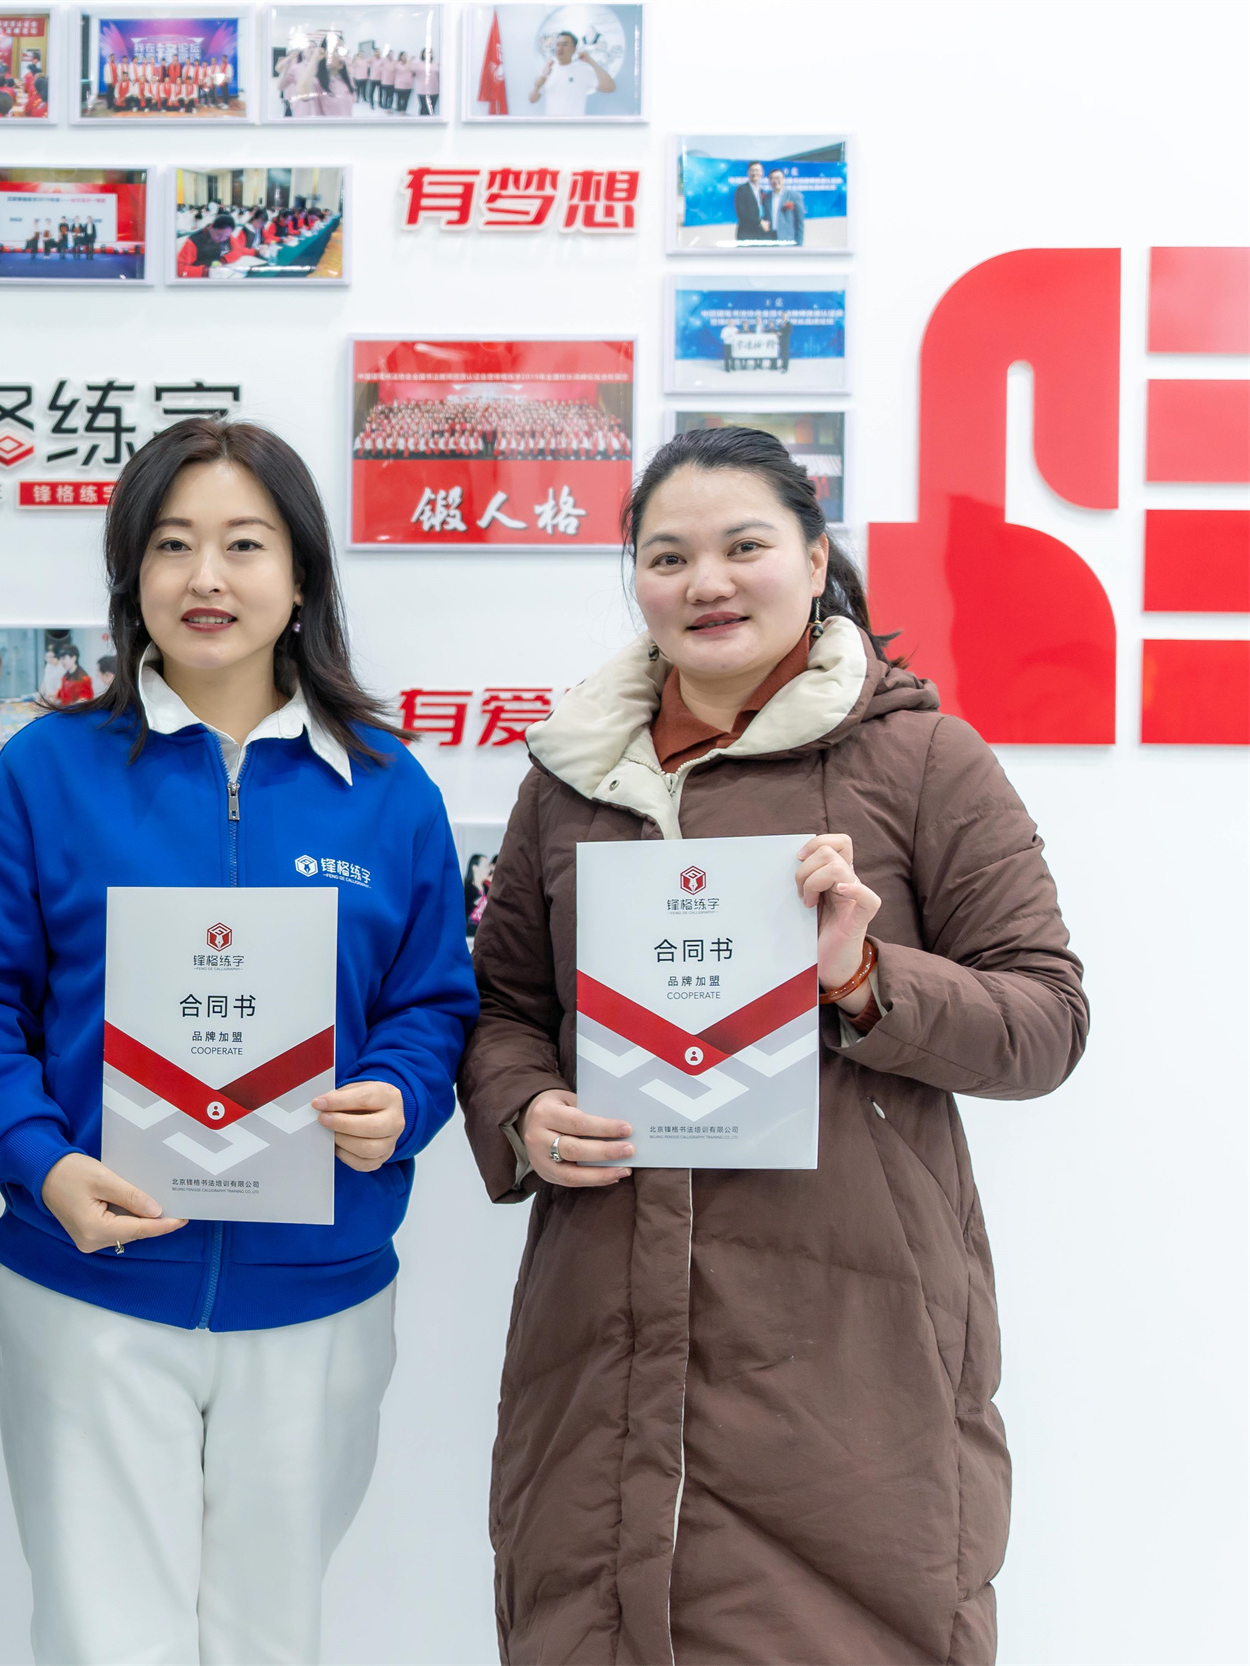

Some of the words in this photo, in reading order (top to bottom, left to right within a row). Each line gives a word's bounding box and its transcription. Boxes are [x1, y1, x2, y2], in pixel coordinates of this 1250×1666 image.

[405, 166, 639, 228] 有梦想
[411, 485, 587, 535] 锻人格
[398, 687, 578, 748] 有爱
[321, 857, 371, 884] 锋格练字
[667, 898, 719, 910] 锋格练字
[654, 937, 733, 963] 合同书
[193, 955, 245, 967] 锋格练字
[667, 975, 720, 987] 品牌加盟
[667, 991, 721, 1000] COOPERATE
[179, 993, 256, 1019] 合同书
[192, 1030, 243, 1043] 品牌加盟
[191, 1047, 243, 1056] COOPERATE
[649, 1125, 739, 1134] 北京锋格书法培训有限公司
[172, 1178, 260, 1188] 北京锋格书法培训有限公司
